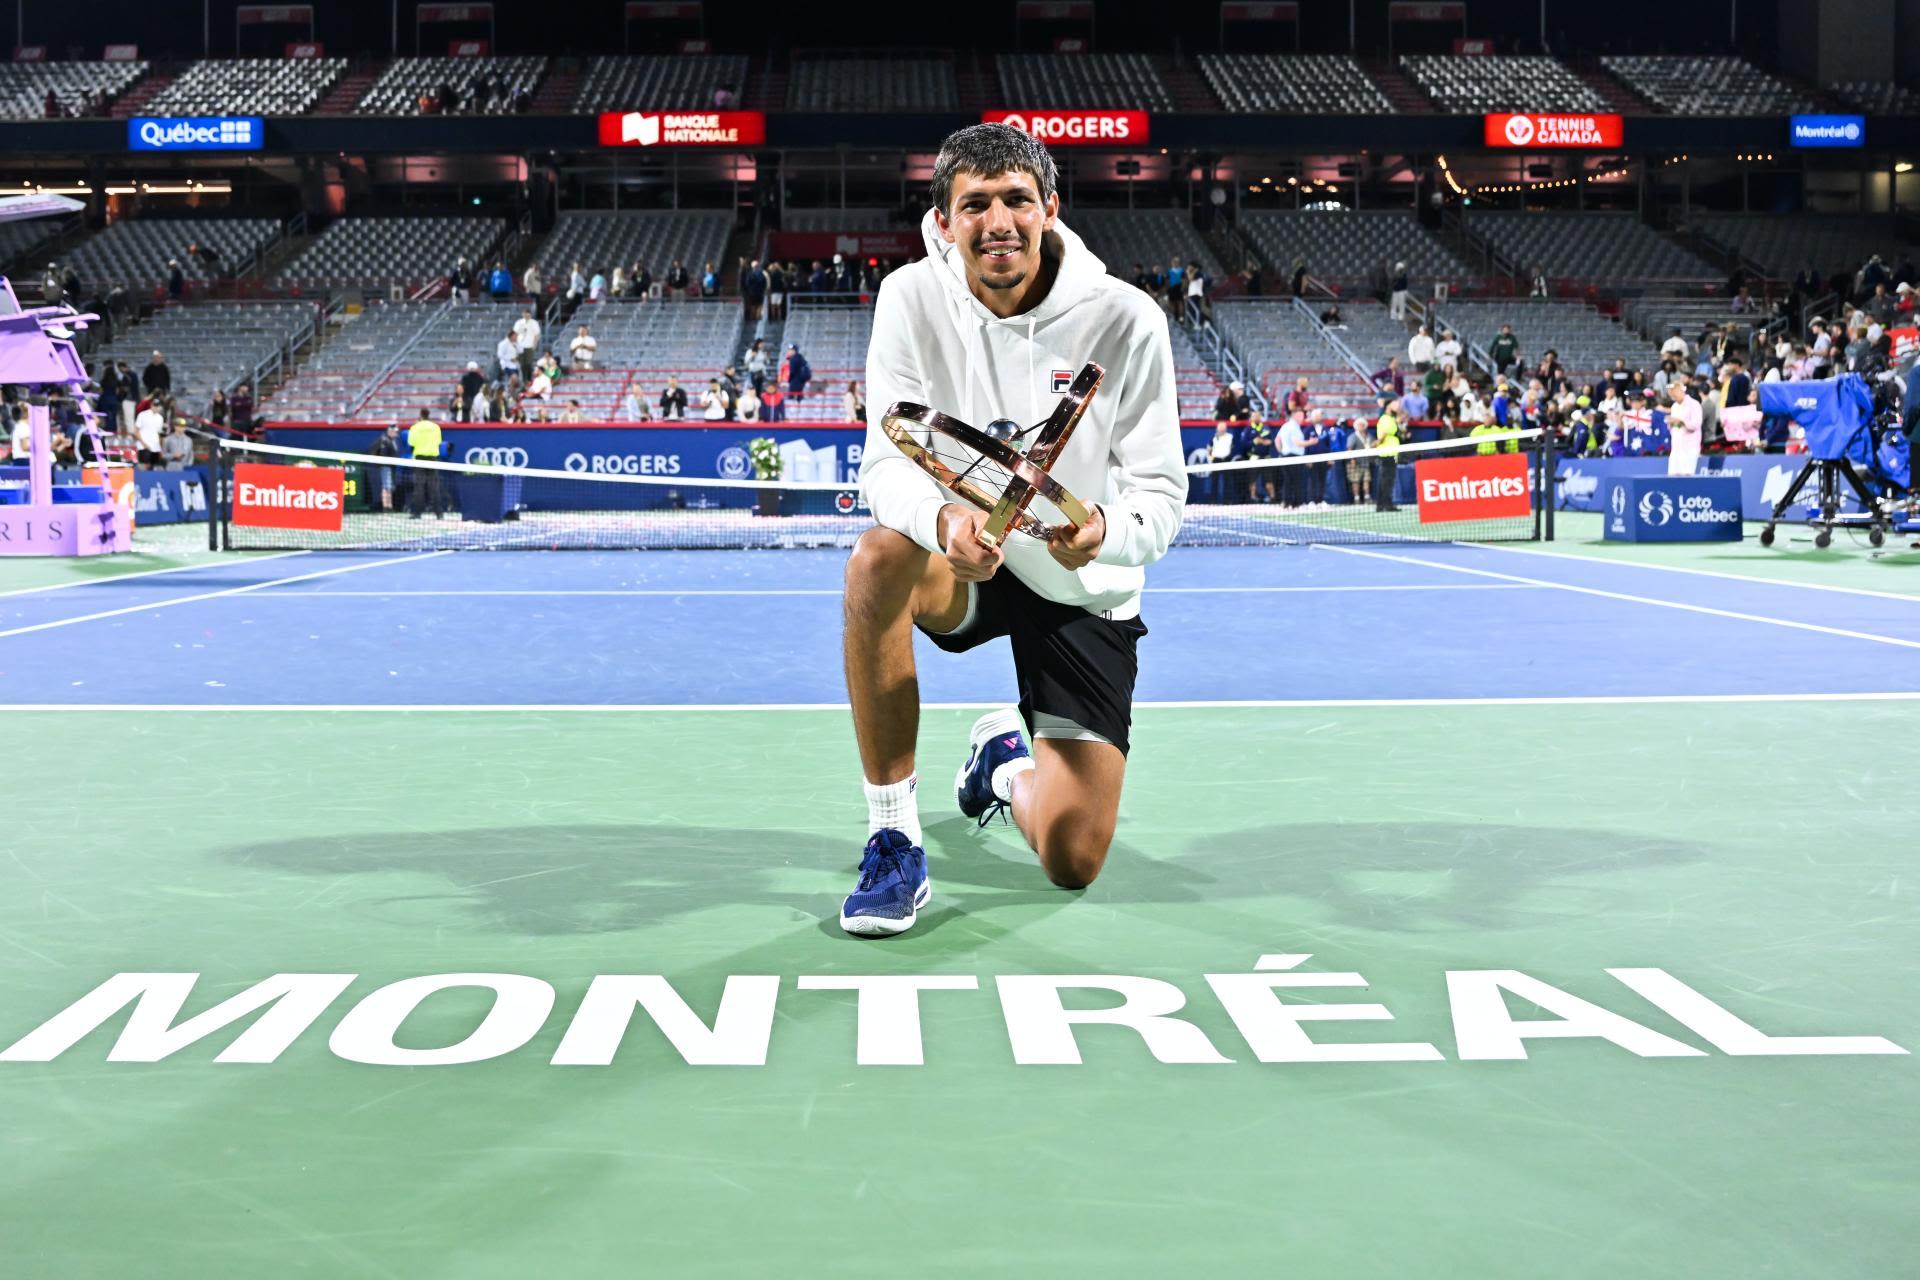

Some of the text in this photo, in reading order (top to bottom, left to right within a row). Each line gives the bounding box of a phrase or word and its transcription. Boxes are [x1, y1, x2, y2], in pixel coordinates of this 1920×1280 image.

[664, 114, 719, 129] BANQUE
[1031, 115, 1130, 139] ROGERS
[1538, 117, 1595, 131] TENNIS
[141, 121, 219, 146] Québec
[664, 128, 738, 143] NATIONALE
[1537, 130, 1603, 144] CANADA
[1795, 123, 1845, 138] Montréal
[592, 454, 681, 476] ROGERS
[239, 483, 339, 510] Emirates
[1421, 474, 1527, 504] Emirates
[1678, 495, 1712, 509] Loto
[1678, 507, 1738, 523] Québec
[0, 953, 1909, 1065] MONTRÉAL
